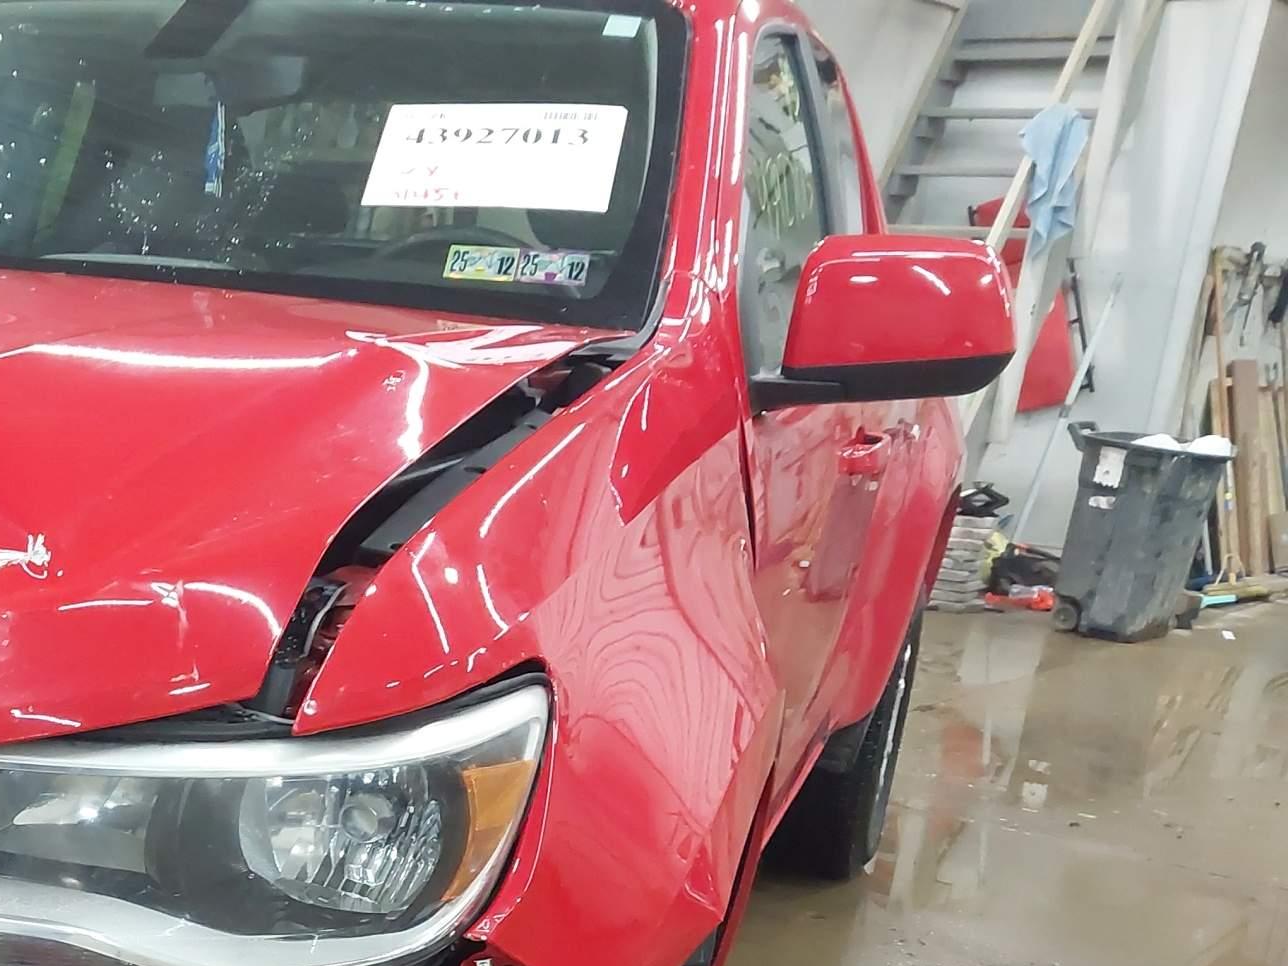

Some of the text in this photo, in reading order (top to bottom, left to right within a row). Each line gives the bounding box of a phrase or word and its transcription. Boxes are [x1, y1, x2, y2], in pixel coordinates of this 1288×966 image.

[405, 127, 589, 145] 43927013
[449, 250, 515, 276] 25 12
[520, 254, 585, 281] 25 12
